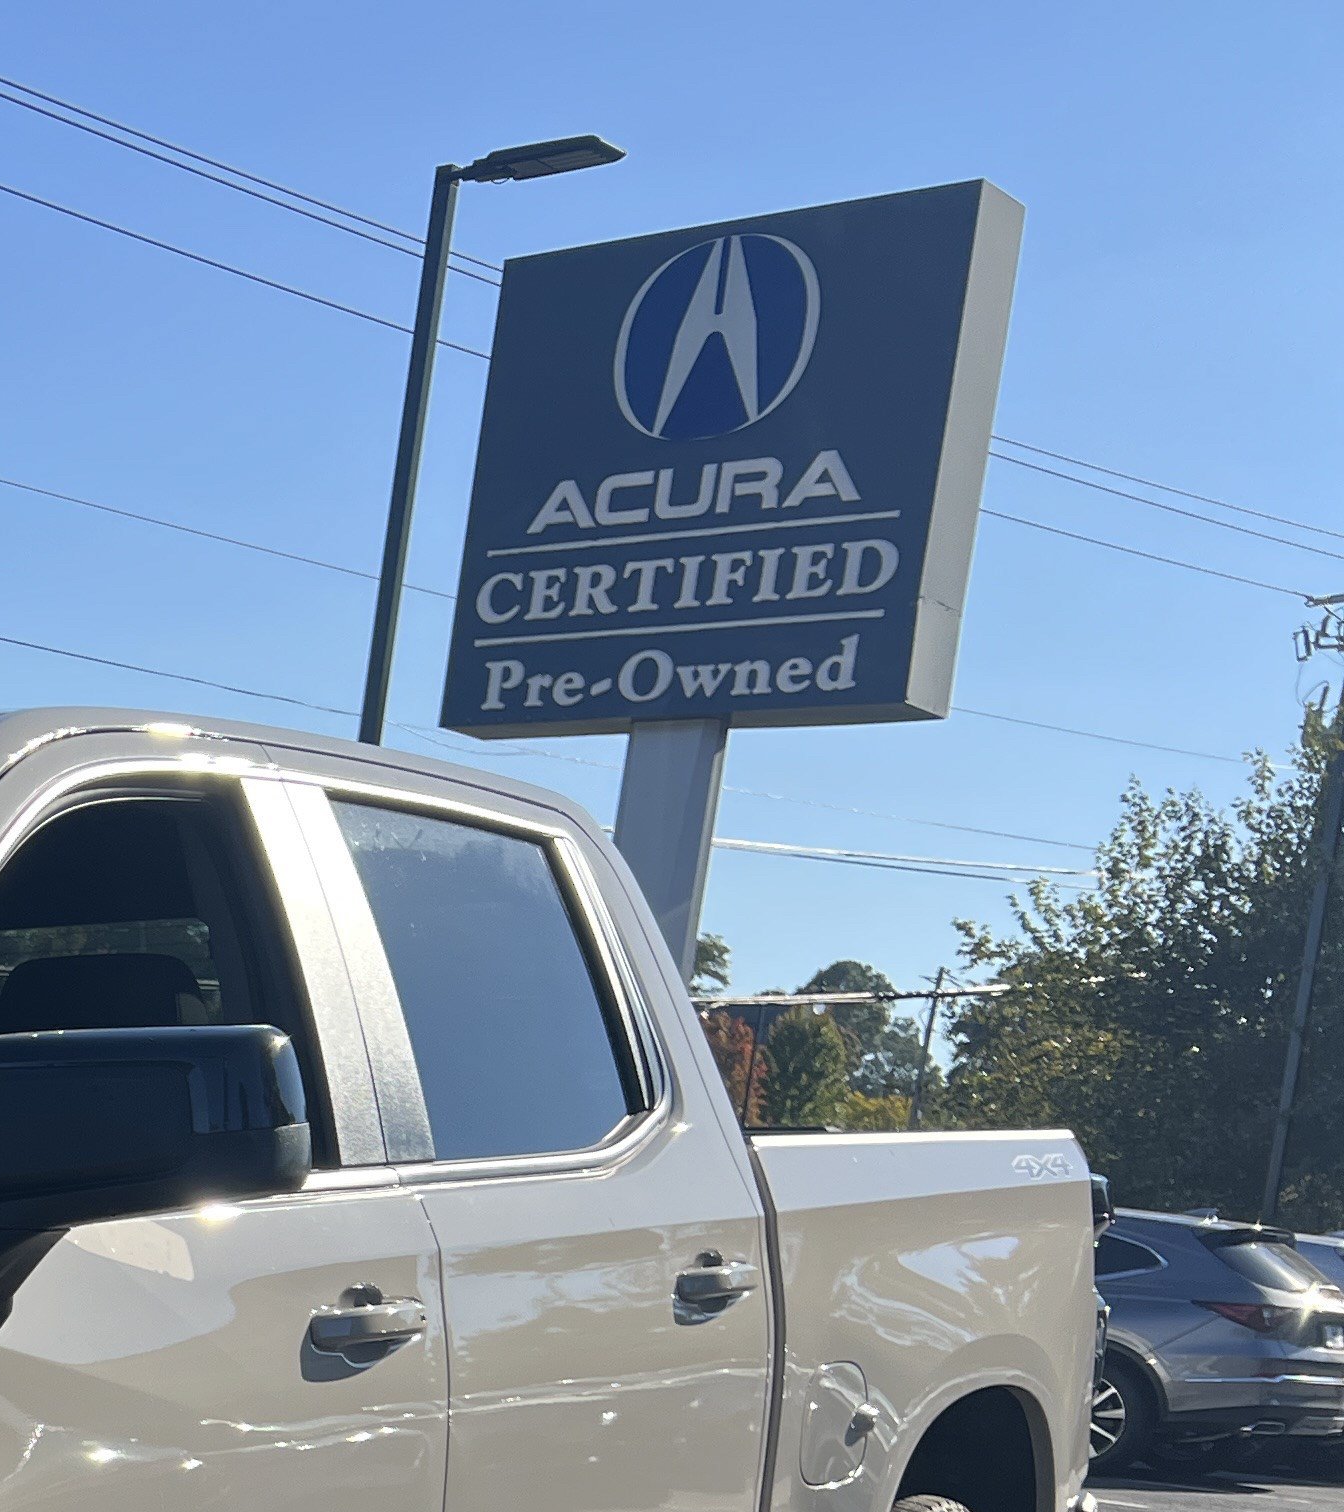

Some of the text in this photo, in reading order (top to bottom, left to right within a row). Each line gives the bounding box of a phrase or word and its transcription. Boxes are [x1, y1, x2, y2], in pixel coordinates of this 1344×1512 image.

[526, 449, 861, 534] ACURA
[475, 537, 900, 625] CERTIFIED
[479, 633, 860, 711] Pre-Owned
